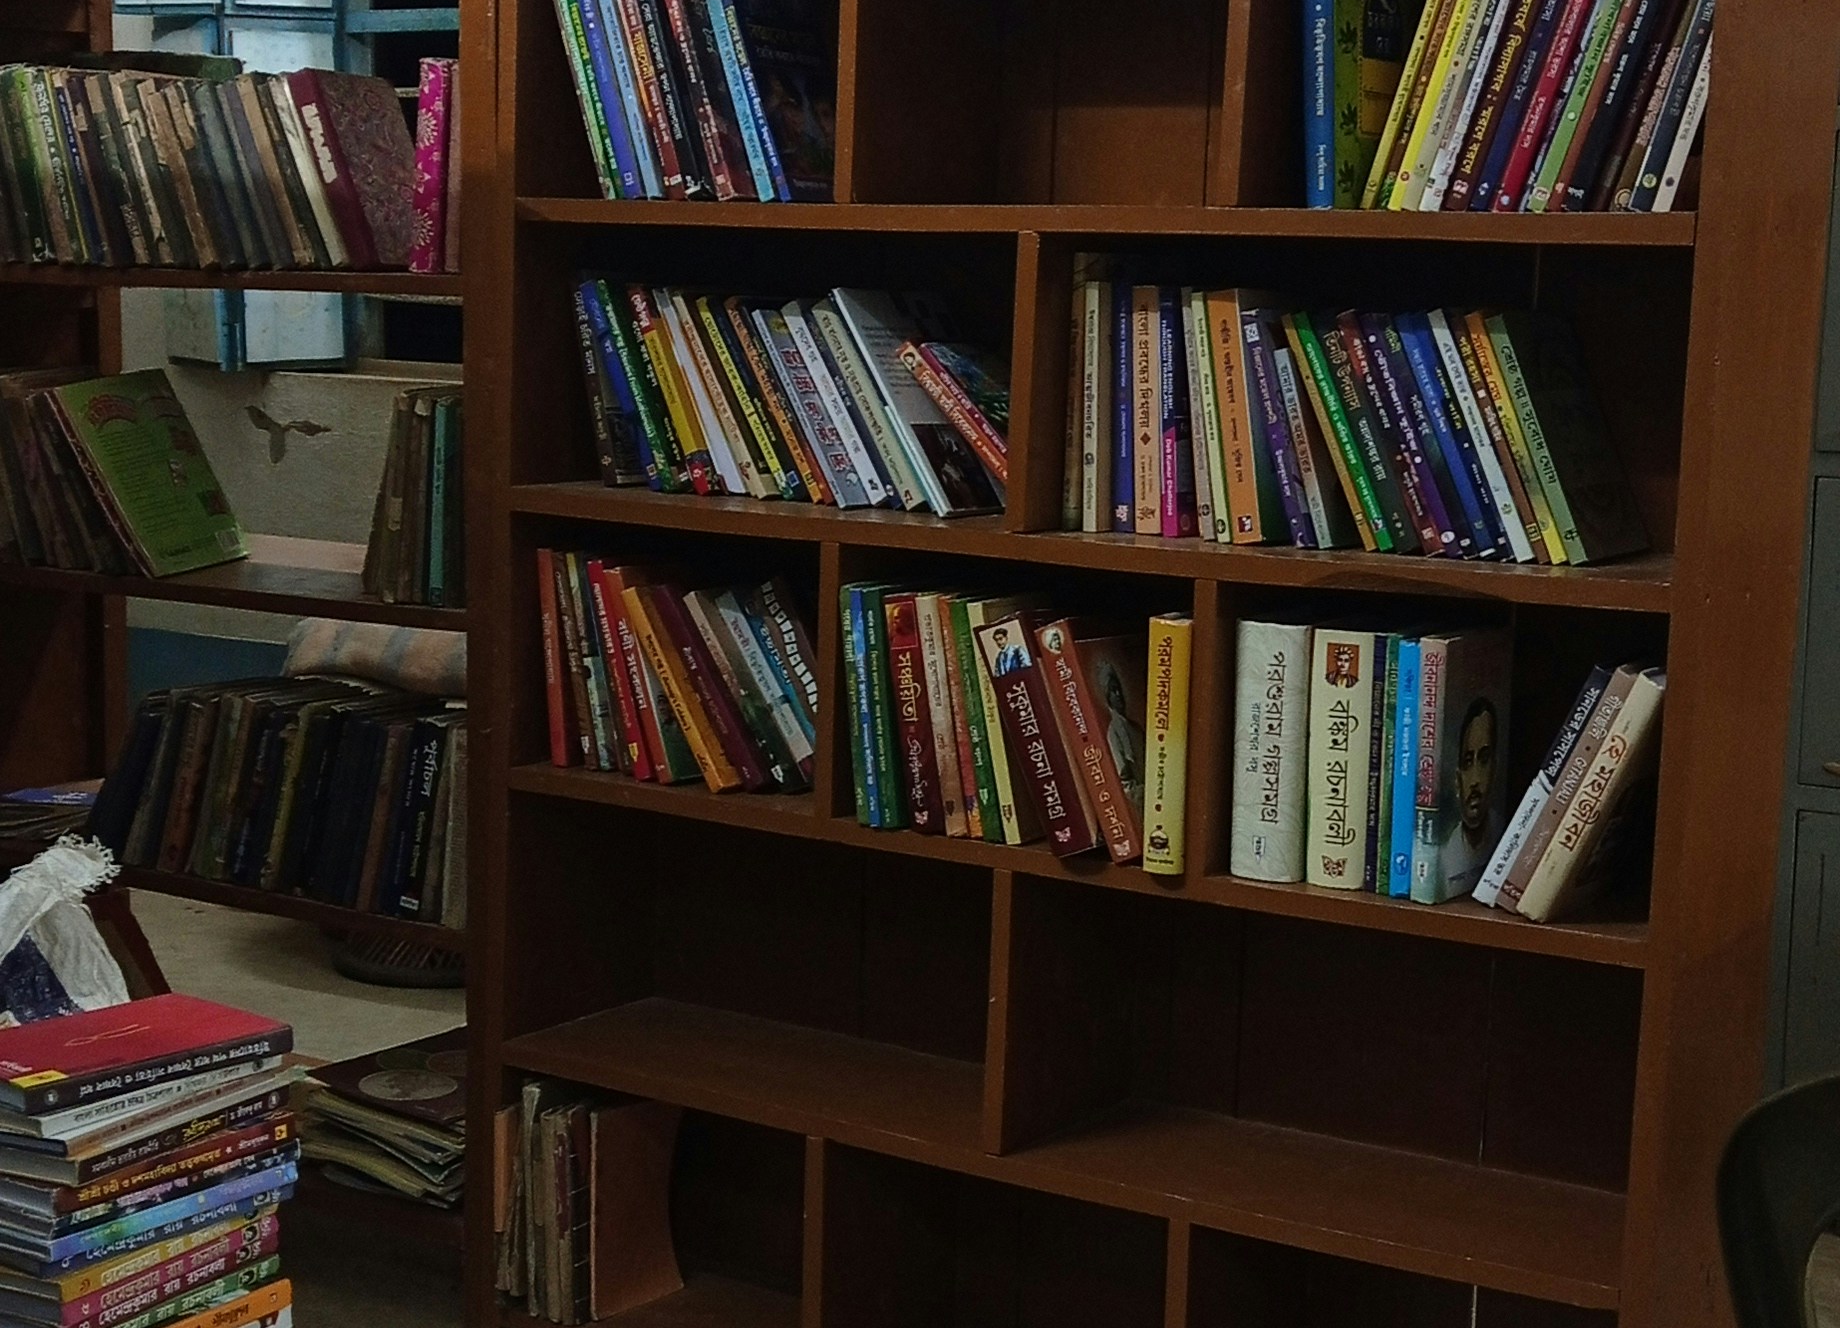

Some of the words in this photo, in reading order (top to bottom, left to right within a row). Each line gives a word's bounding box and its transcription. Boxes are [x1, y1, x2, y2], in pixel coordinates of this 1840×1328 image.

[894, 650, 924, 723] সঞ্চয়িতা
[1002, 680, 1041, 739] সুকুমার
[1265, 654, 1286, 733] পরশুরাম
[1327, 700, 1358, 750] বঙ্কিম
[1025, 738, 1053, 779] রচনা
[1081, 742, 1110, 786] জীবন
[1260, 746, 1282, 823] গল্পসমগ্র
[1554, 755, 1587, 805] GITANJALI
[1037, 779, 1067, 821] সমগ্র
[1324, 762, 1357, 844] রচনাবলী
